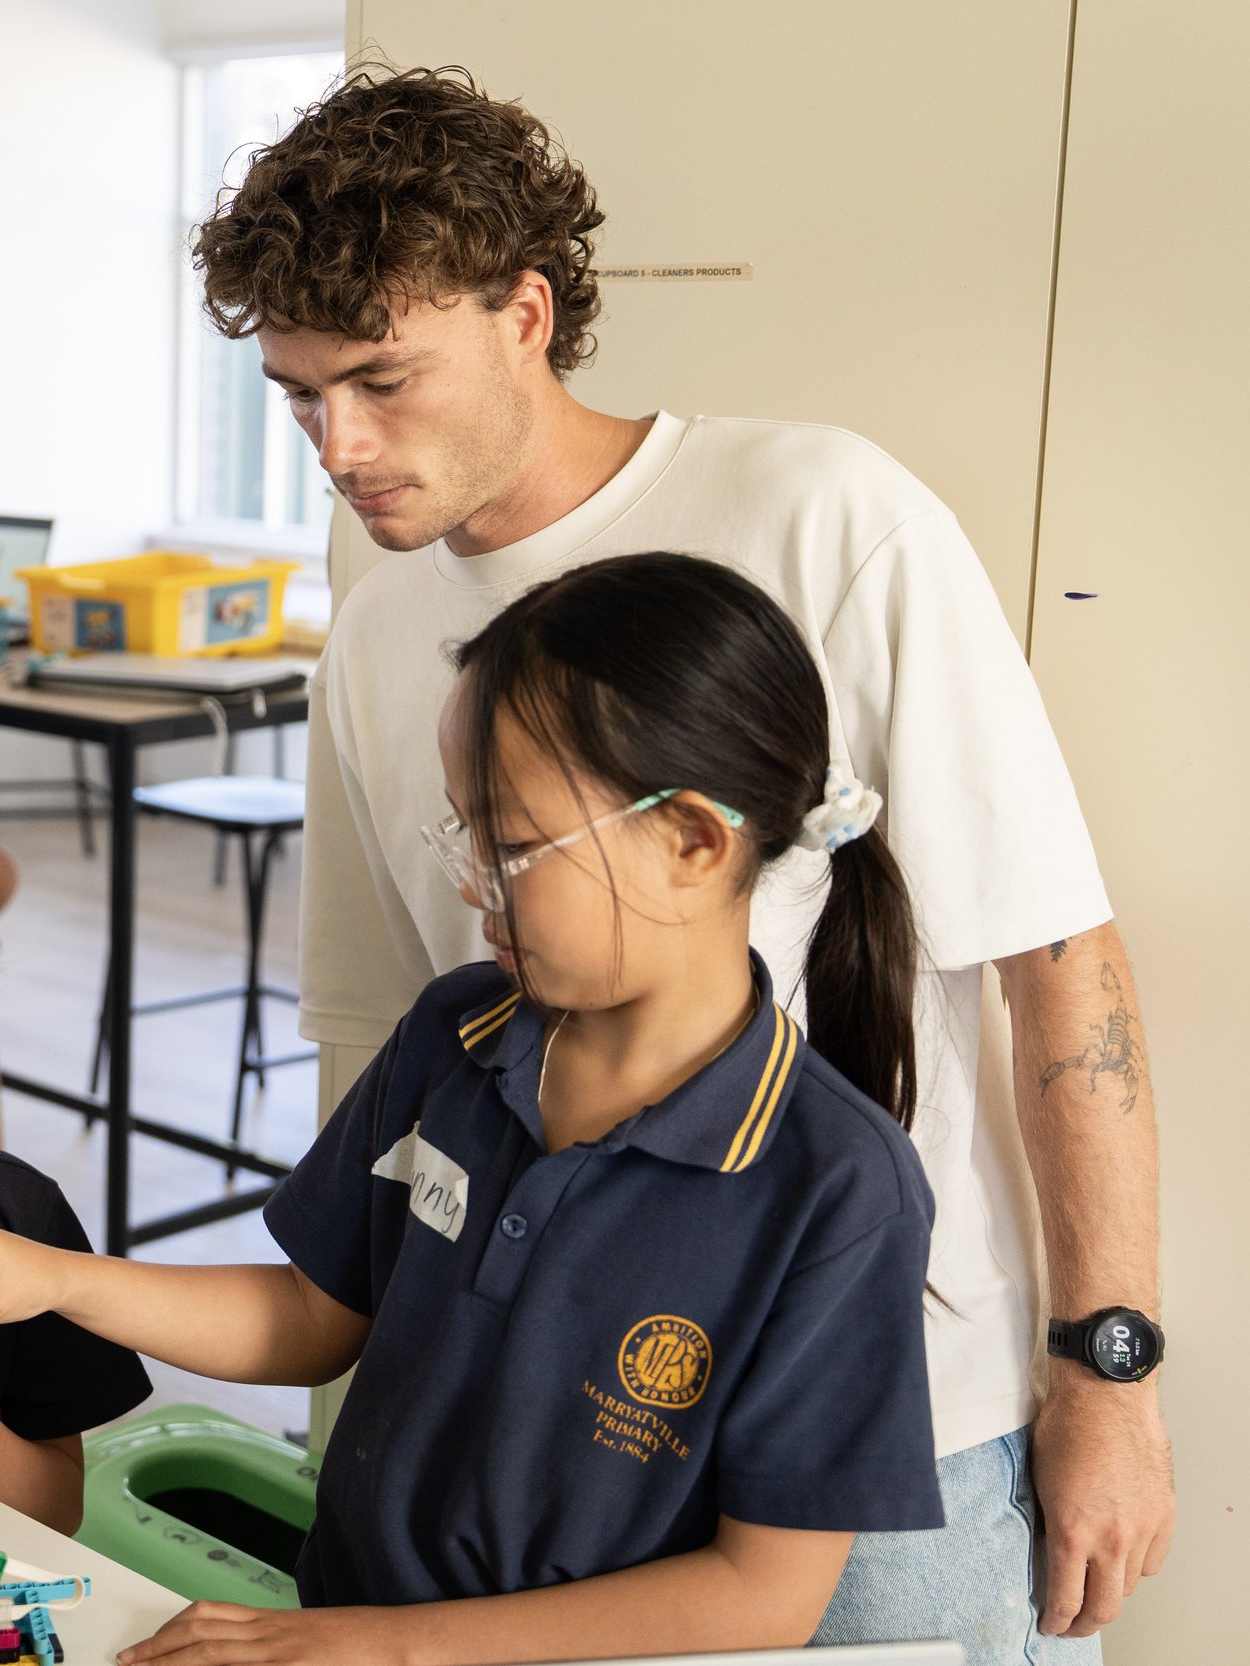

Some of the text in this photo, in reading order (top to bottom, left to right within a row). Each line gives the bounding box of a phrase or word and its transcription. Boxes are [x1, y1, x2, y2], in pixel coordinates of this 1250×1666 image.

[652, 269, 694, 277] CLEANERS
[696, 268, 742, 276] PRODUCTS
[411, 1171, 460, 1234] nny
[651, 1322, 707, 1359] AMBITION
[1112, 1325, 1131, 1353] 04
[625, 1353, 640, 1388] WITH
[1112, 1353, 1120, 1364] 59
[582, 1379, 690, 1461] MARRYATVILLE
[595, 1410, 663, 1453] PRIMARY
[593, 1429, 650, 1464] Est. 1884
